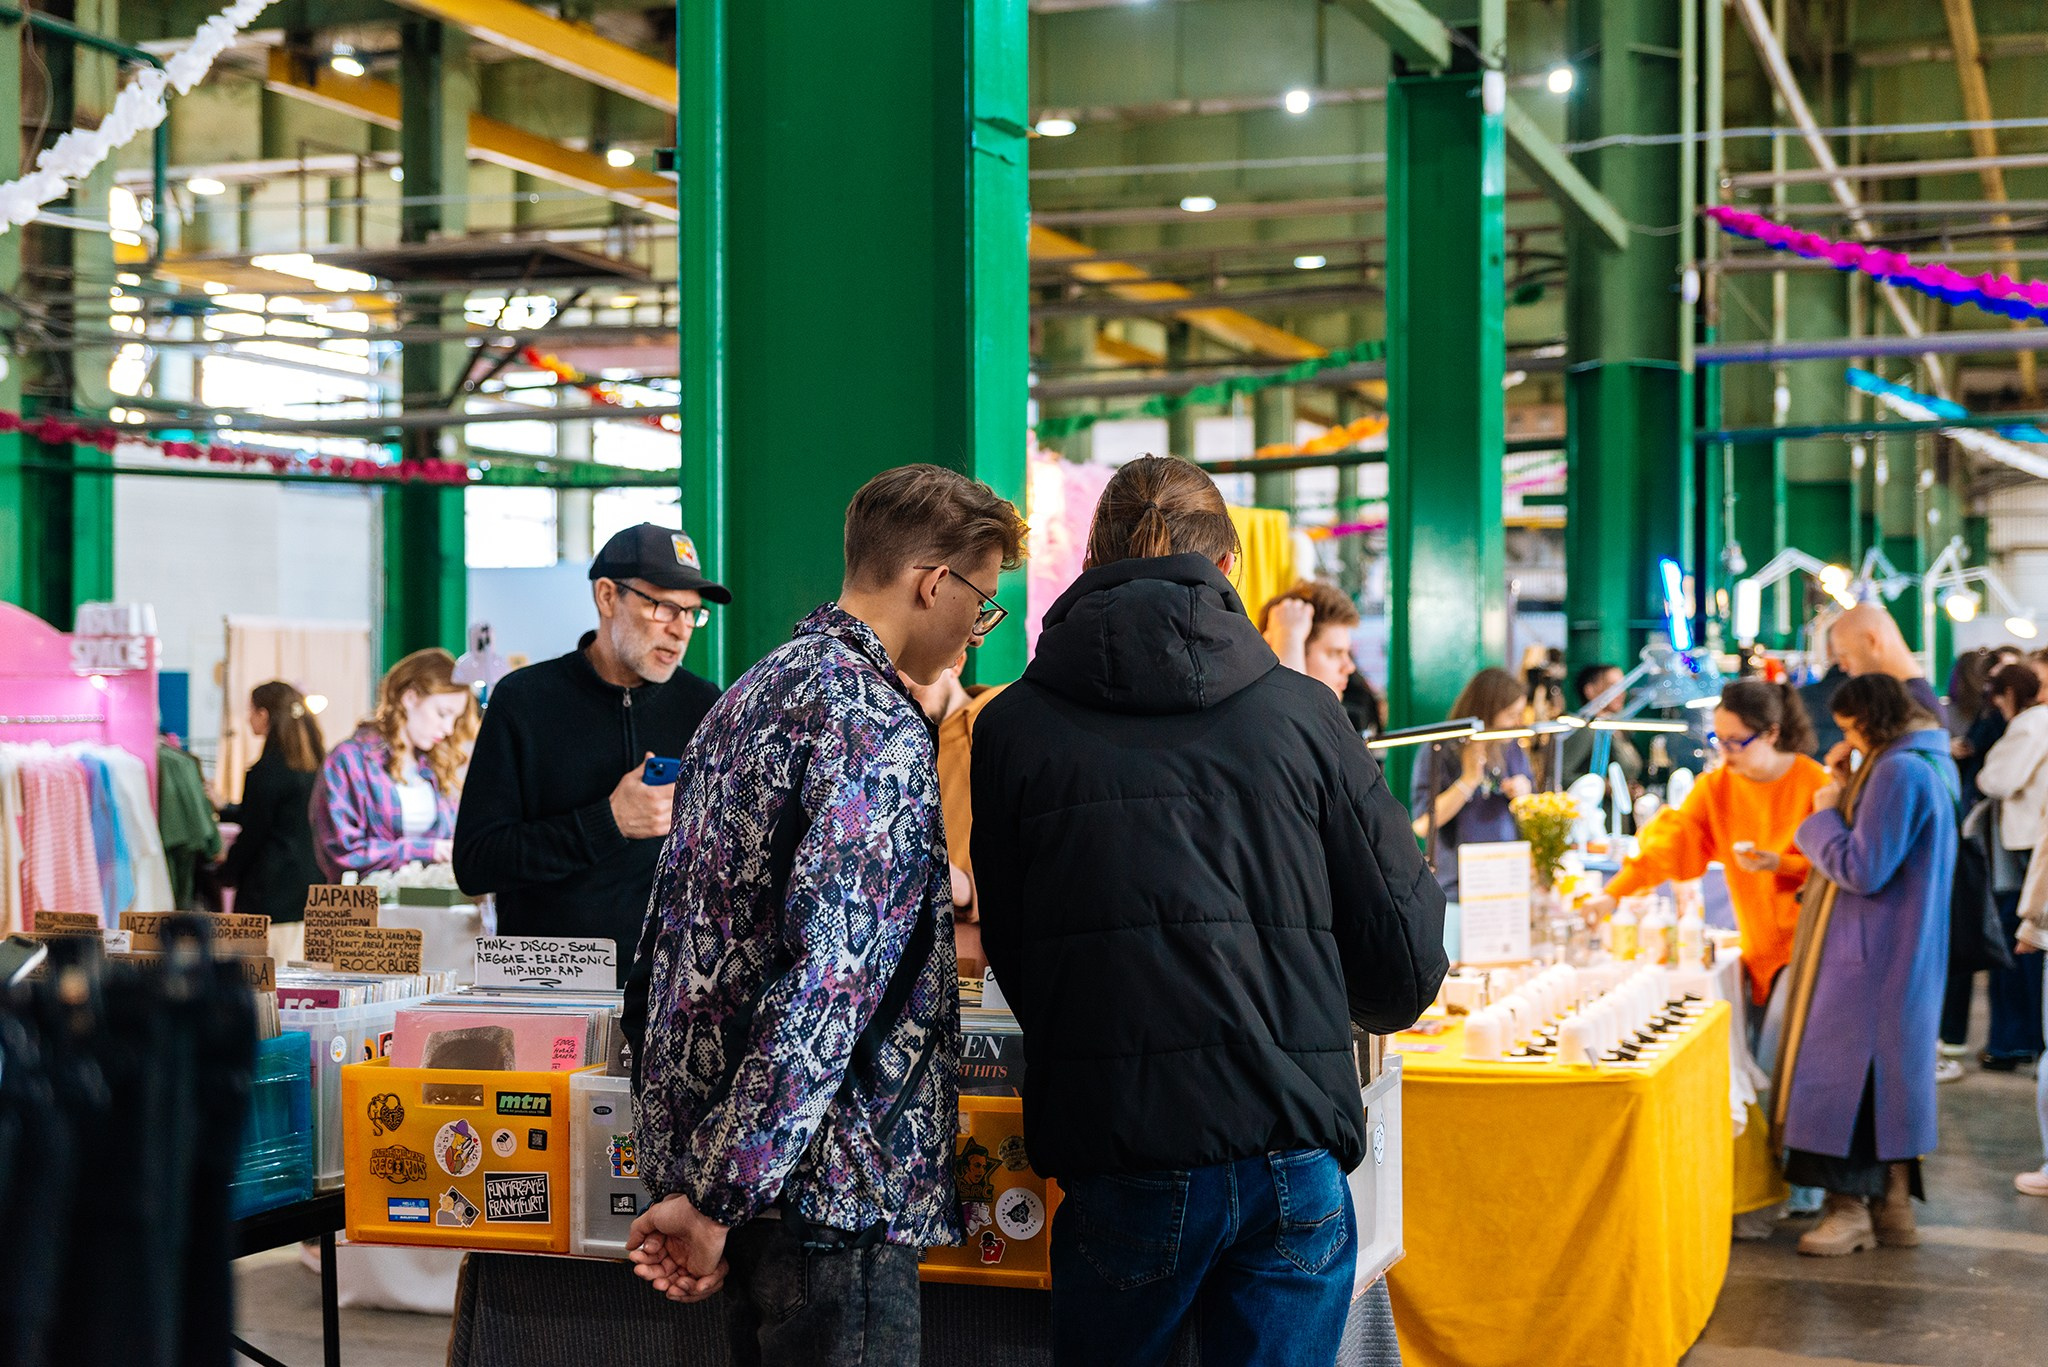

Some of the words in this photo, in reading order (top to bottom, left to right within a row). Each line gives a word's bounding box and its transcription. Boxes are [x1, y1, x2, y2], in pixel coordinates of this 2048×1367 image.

[309, 887, 366, 908] JAPAN
[388, 959, 419, 973] BLUES
[974, 1064, 1008, 1078] HITS
[499, 1094, 547, 1110] mtn
[488, 1195, 544, 1217] FRANKFURT
